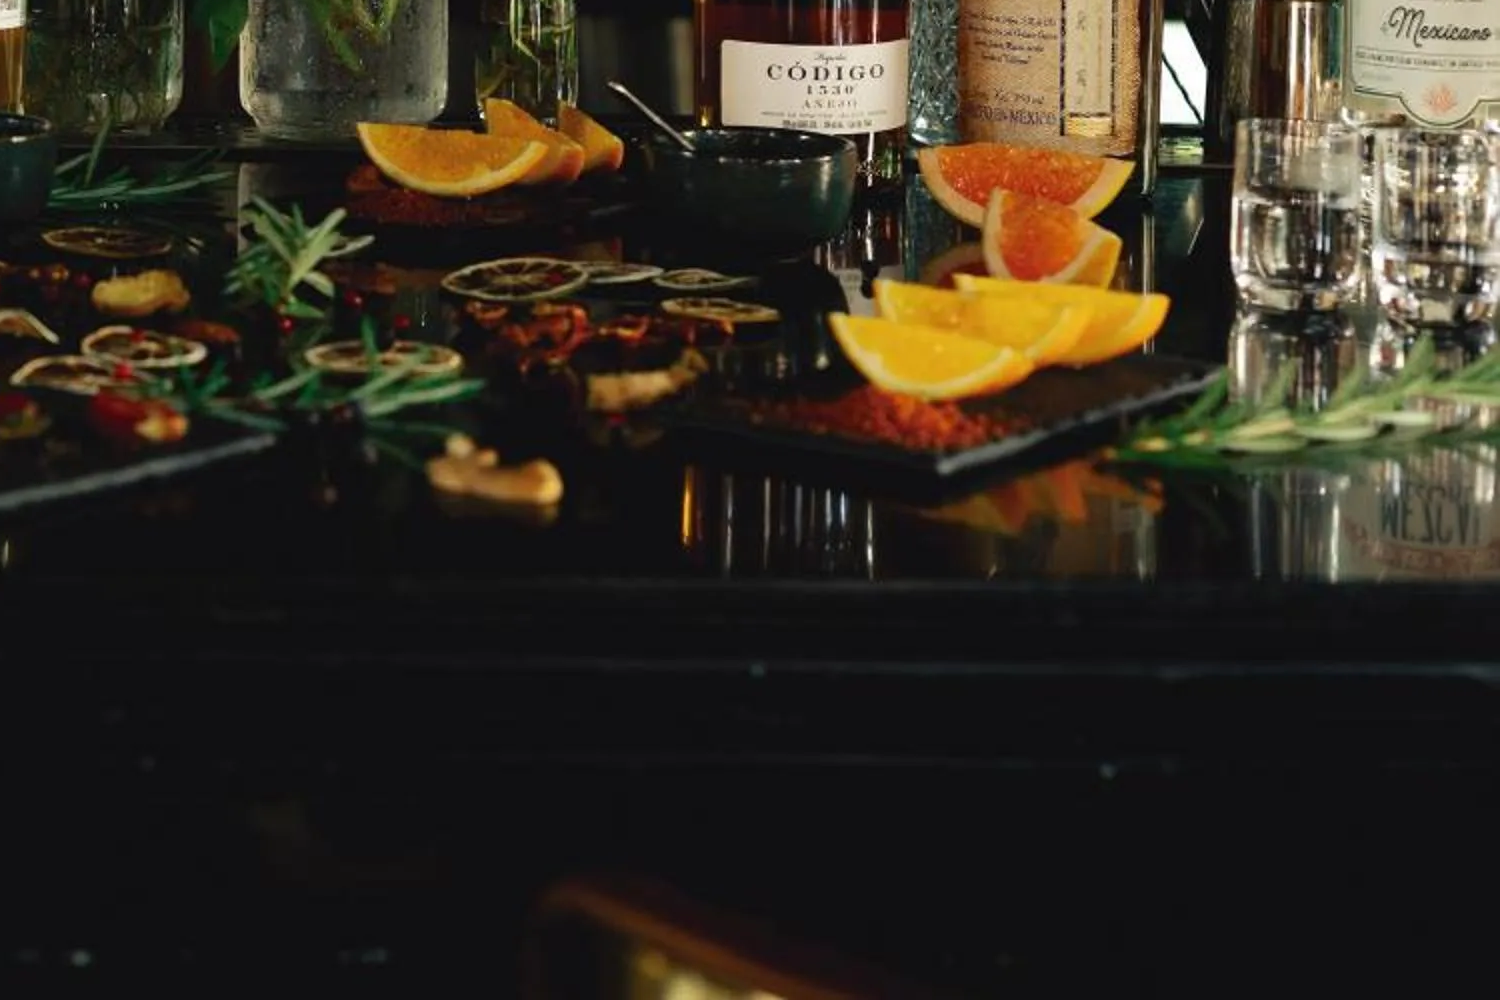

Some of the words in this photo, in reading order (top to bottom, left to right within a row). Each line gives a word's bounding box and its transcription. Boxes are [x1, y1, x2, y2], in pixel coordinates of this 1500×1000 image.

[1388, 5, 1491, 48] Mexicano
[766, 61, 885, 82] CÓDIGO
[806, 84, 855, 96] 1530
